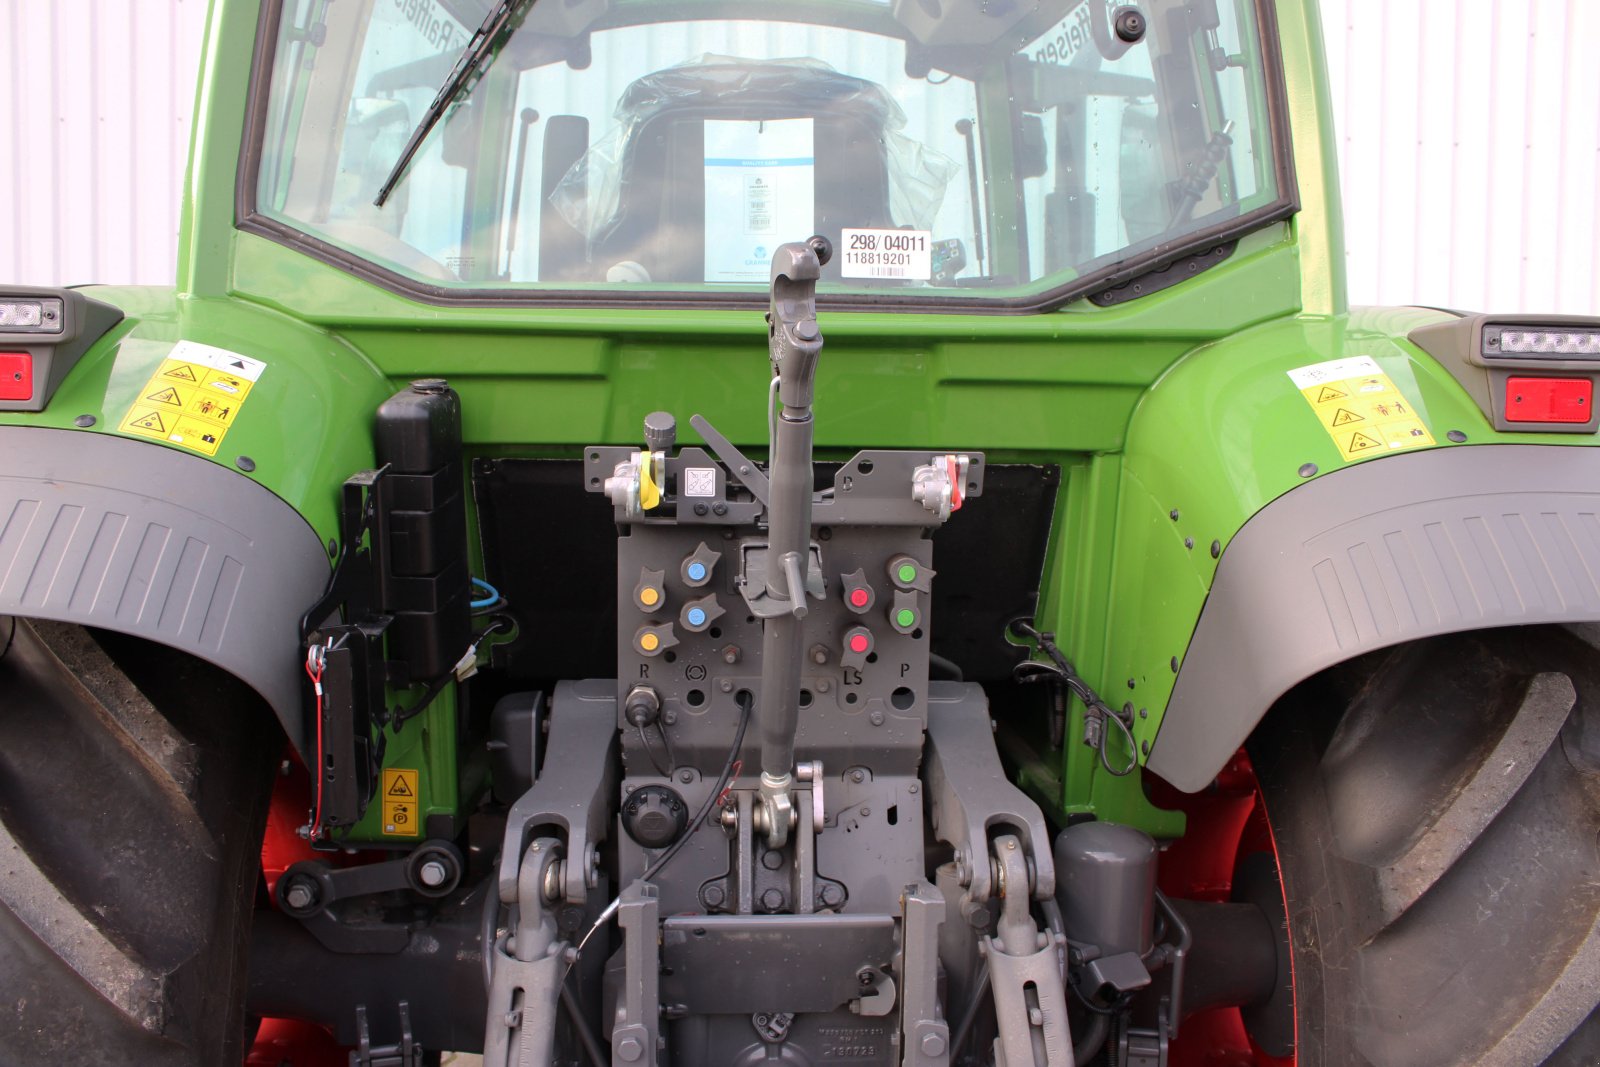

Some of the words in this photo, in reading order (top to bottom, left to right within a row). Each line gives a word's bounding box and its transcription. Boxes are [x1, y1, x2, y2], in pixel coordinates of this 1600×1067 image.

[884, 235, 924, 251] 04011
[846, 252, 910, 265] 118819201
[640, 664, 649, 678] R
[844, 669, 863, 685] LS
[900, 663, 910, 678] P
